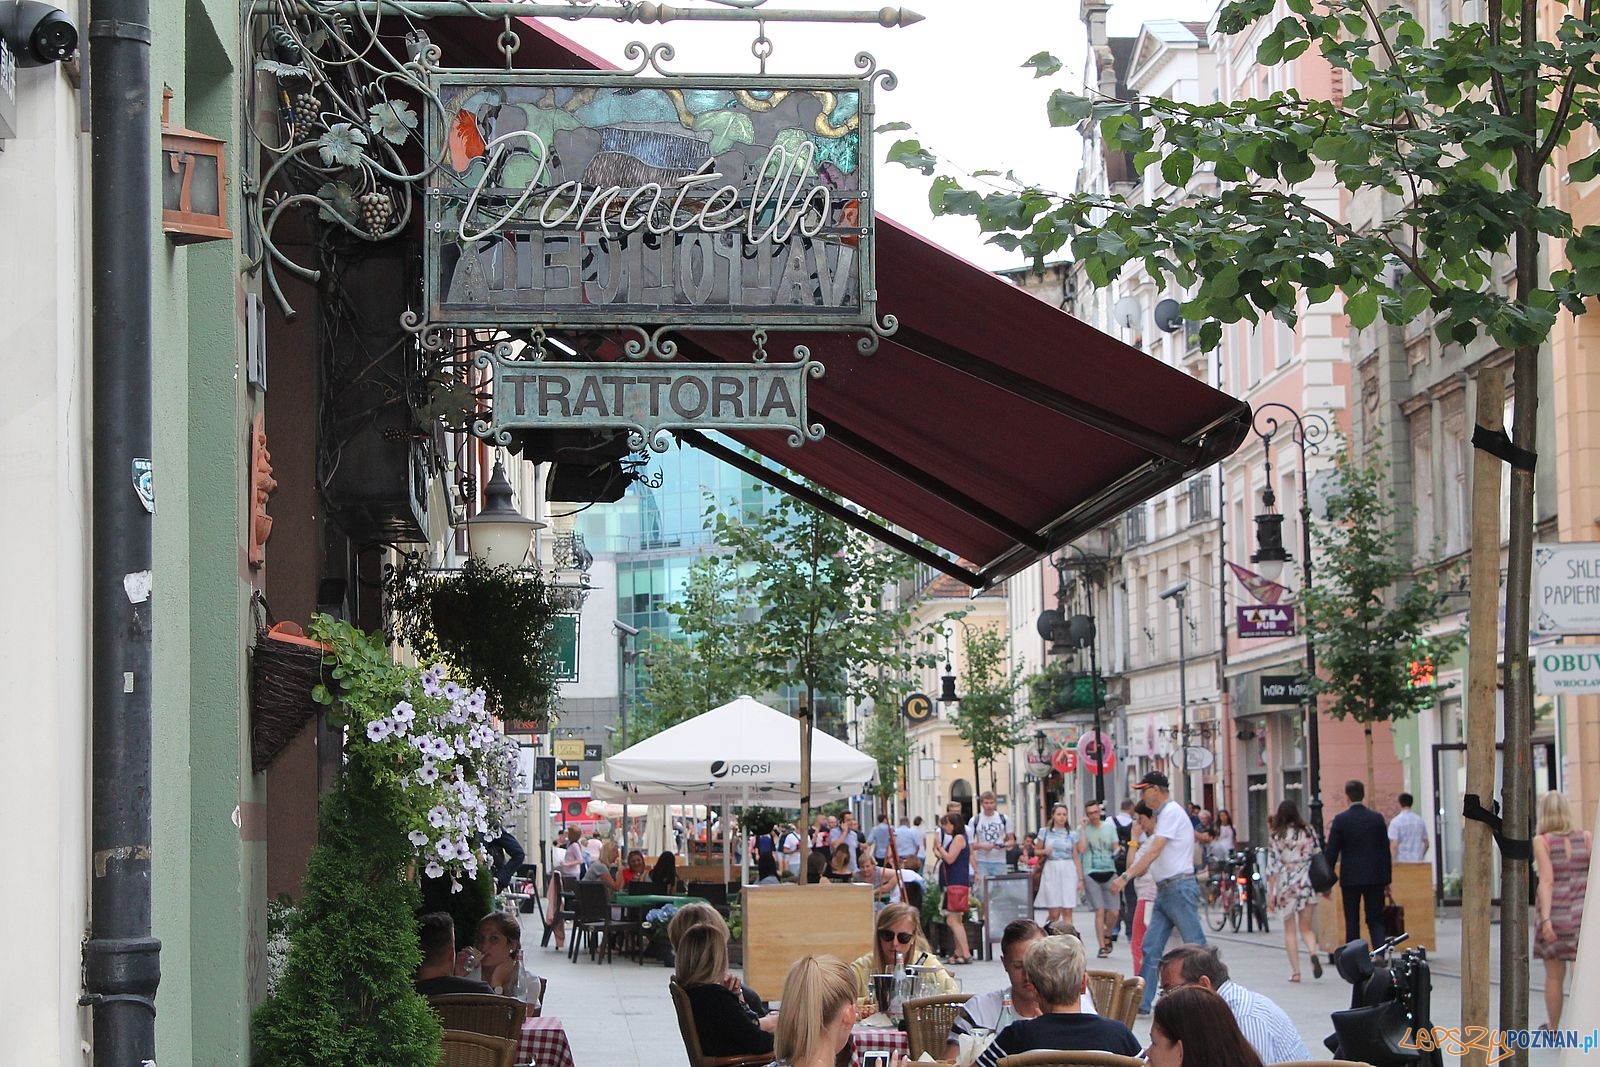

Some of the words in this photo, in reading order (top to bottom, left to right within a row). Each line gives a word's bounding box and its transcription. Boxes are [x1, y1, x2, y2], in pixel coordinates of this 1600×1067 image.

[168, 152, 196, 212] 7
[459, 130, 831, 243] Donatello
[502, 375, 797, 418] TRATTORIA
[1256, 621, 1277, 629] PUB
[907, 697, 929, 719] C
[731, 762, 771, 776] pepsi
